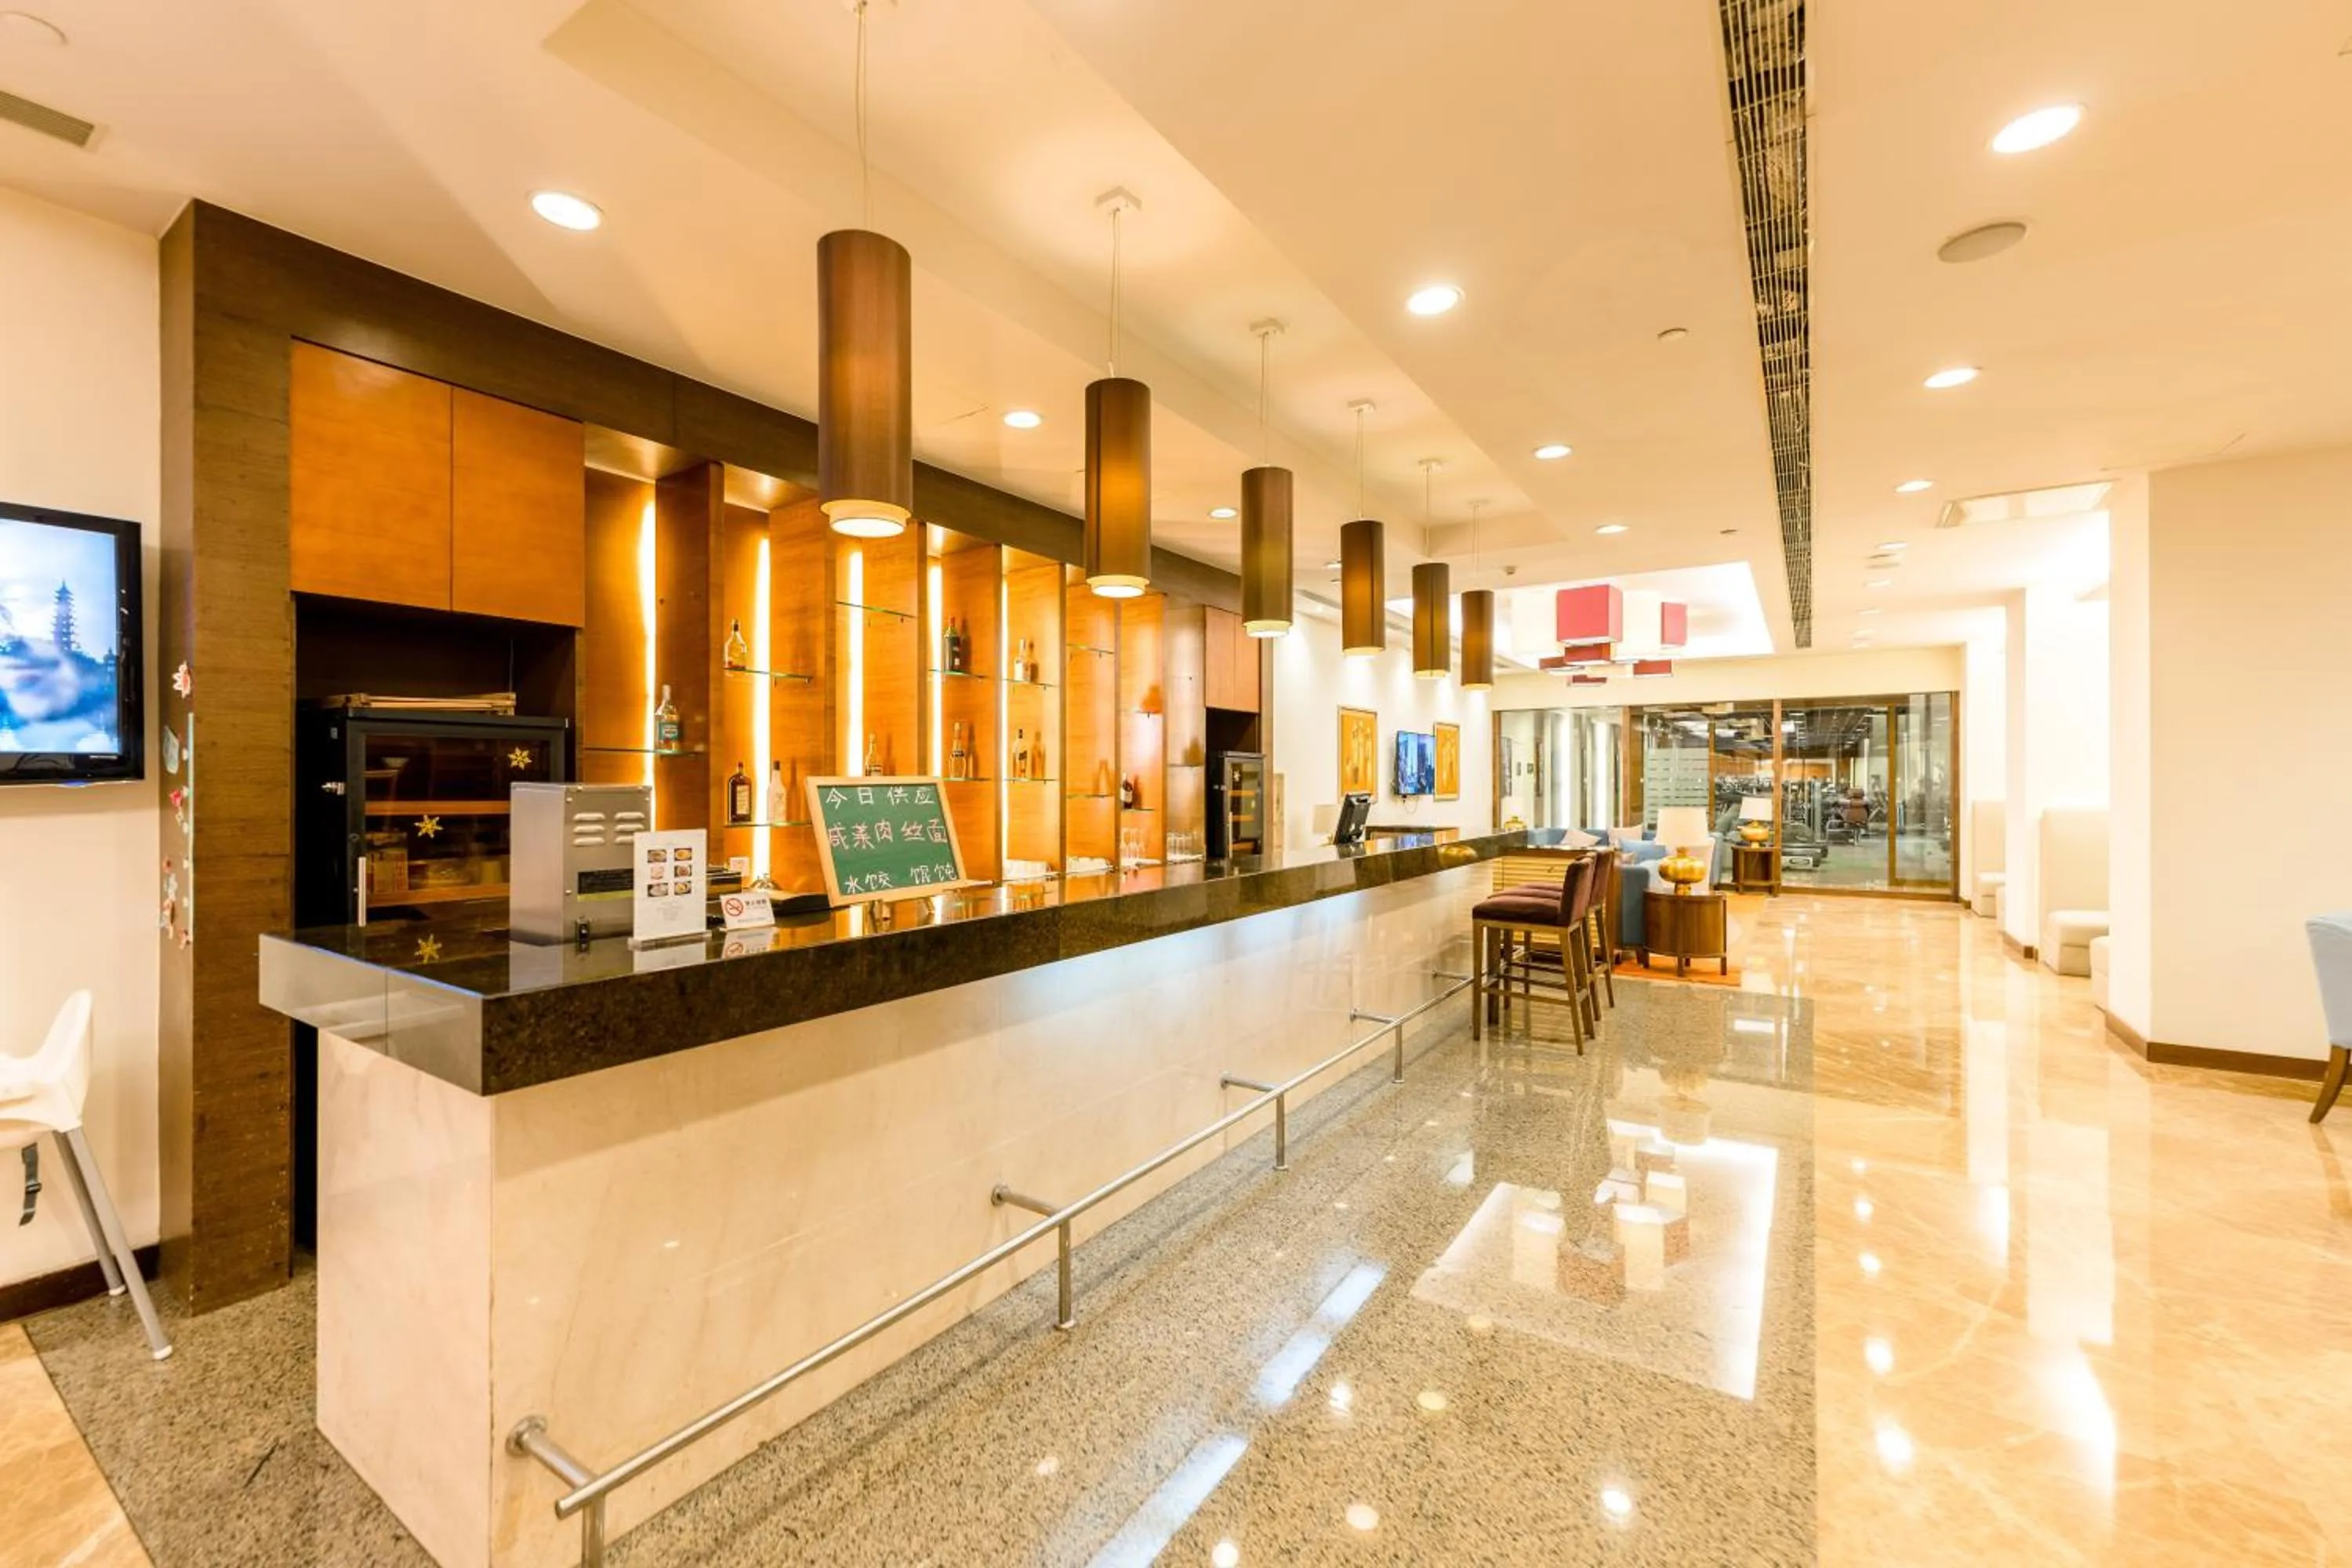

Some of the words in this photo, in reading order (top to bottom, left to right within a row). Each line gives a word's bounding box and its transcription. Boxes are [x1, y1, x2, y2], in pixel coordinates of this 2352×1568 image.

[826, 786, 935, 810] 今日供应
[827, 818, 948, 851] 咸菜肉丝面
[844, 870, 894, 895] 水饺
[910, 862, 957, 885] 馄饨
